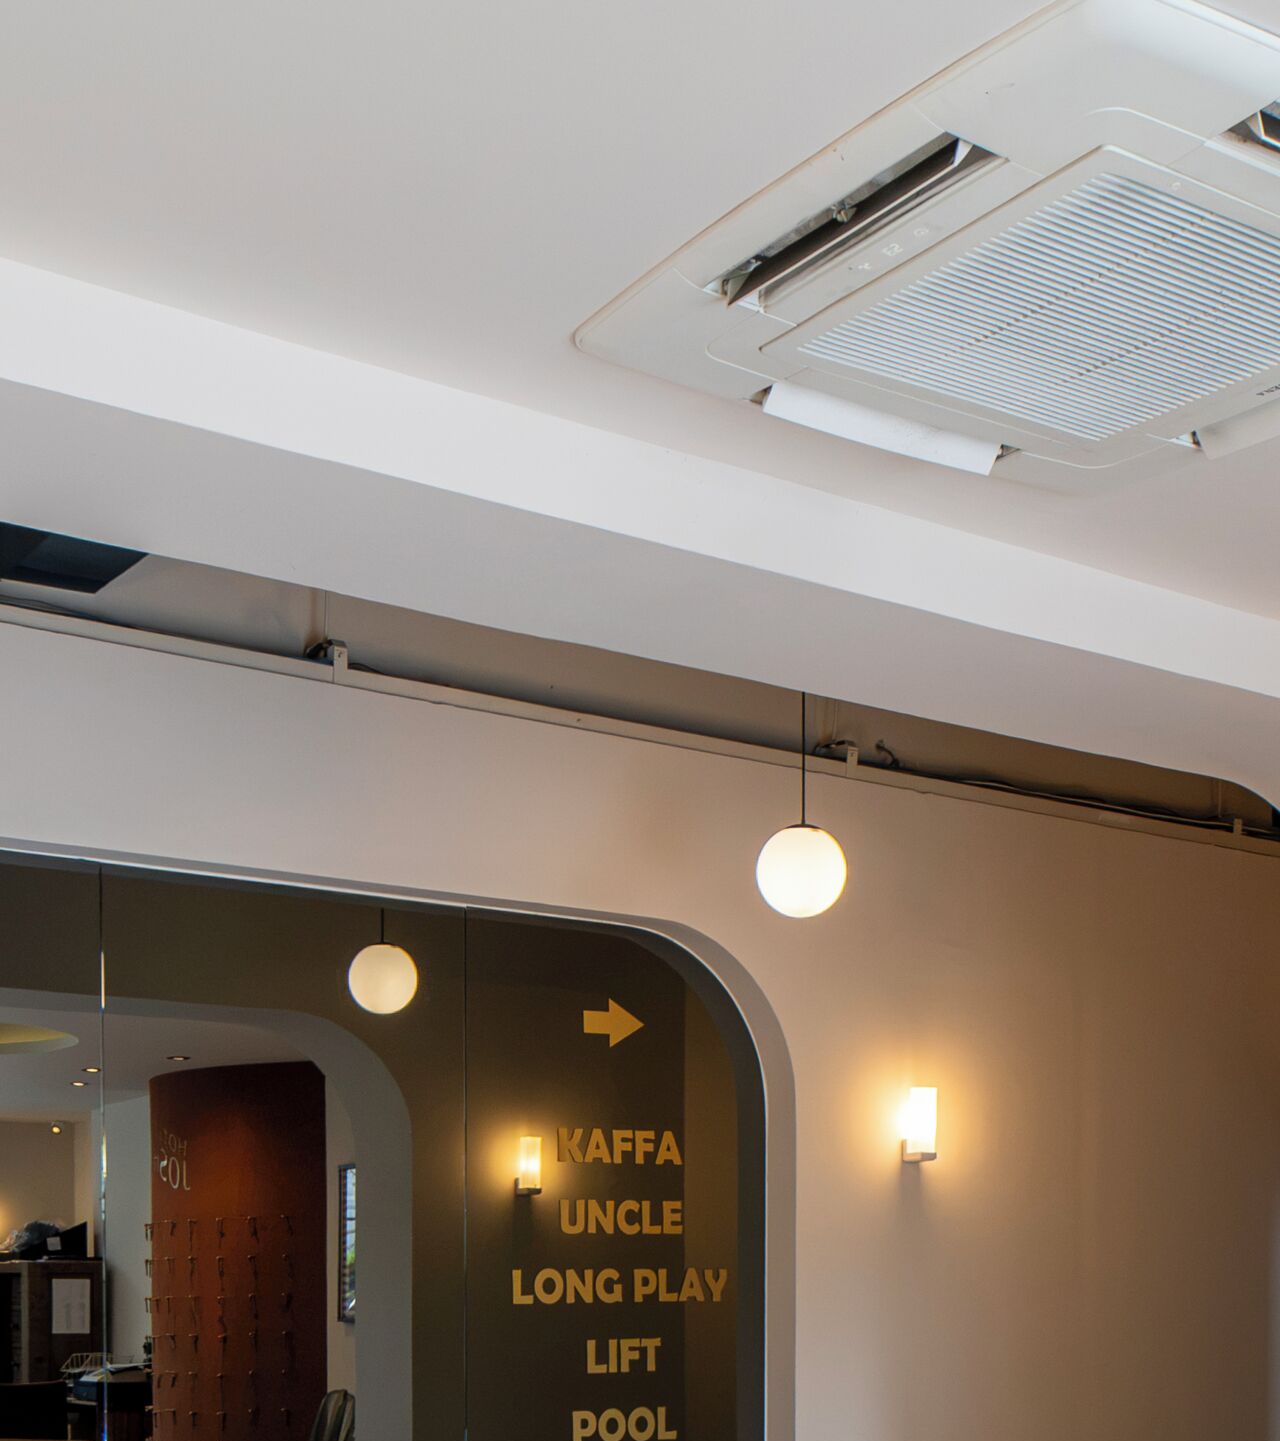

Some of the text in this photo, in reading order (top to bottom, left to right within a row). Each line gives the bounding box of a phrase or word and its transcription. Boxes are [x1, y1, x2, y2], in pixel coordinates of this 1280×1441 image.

[557, 1127, 683, 1166] KAFFA
[560, 1199, 684, 1236] UNCLE
[512, 1263, 728, 1305] LONG PLAY
[586, 1337, 662, 1375] LIFT
